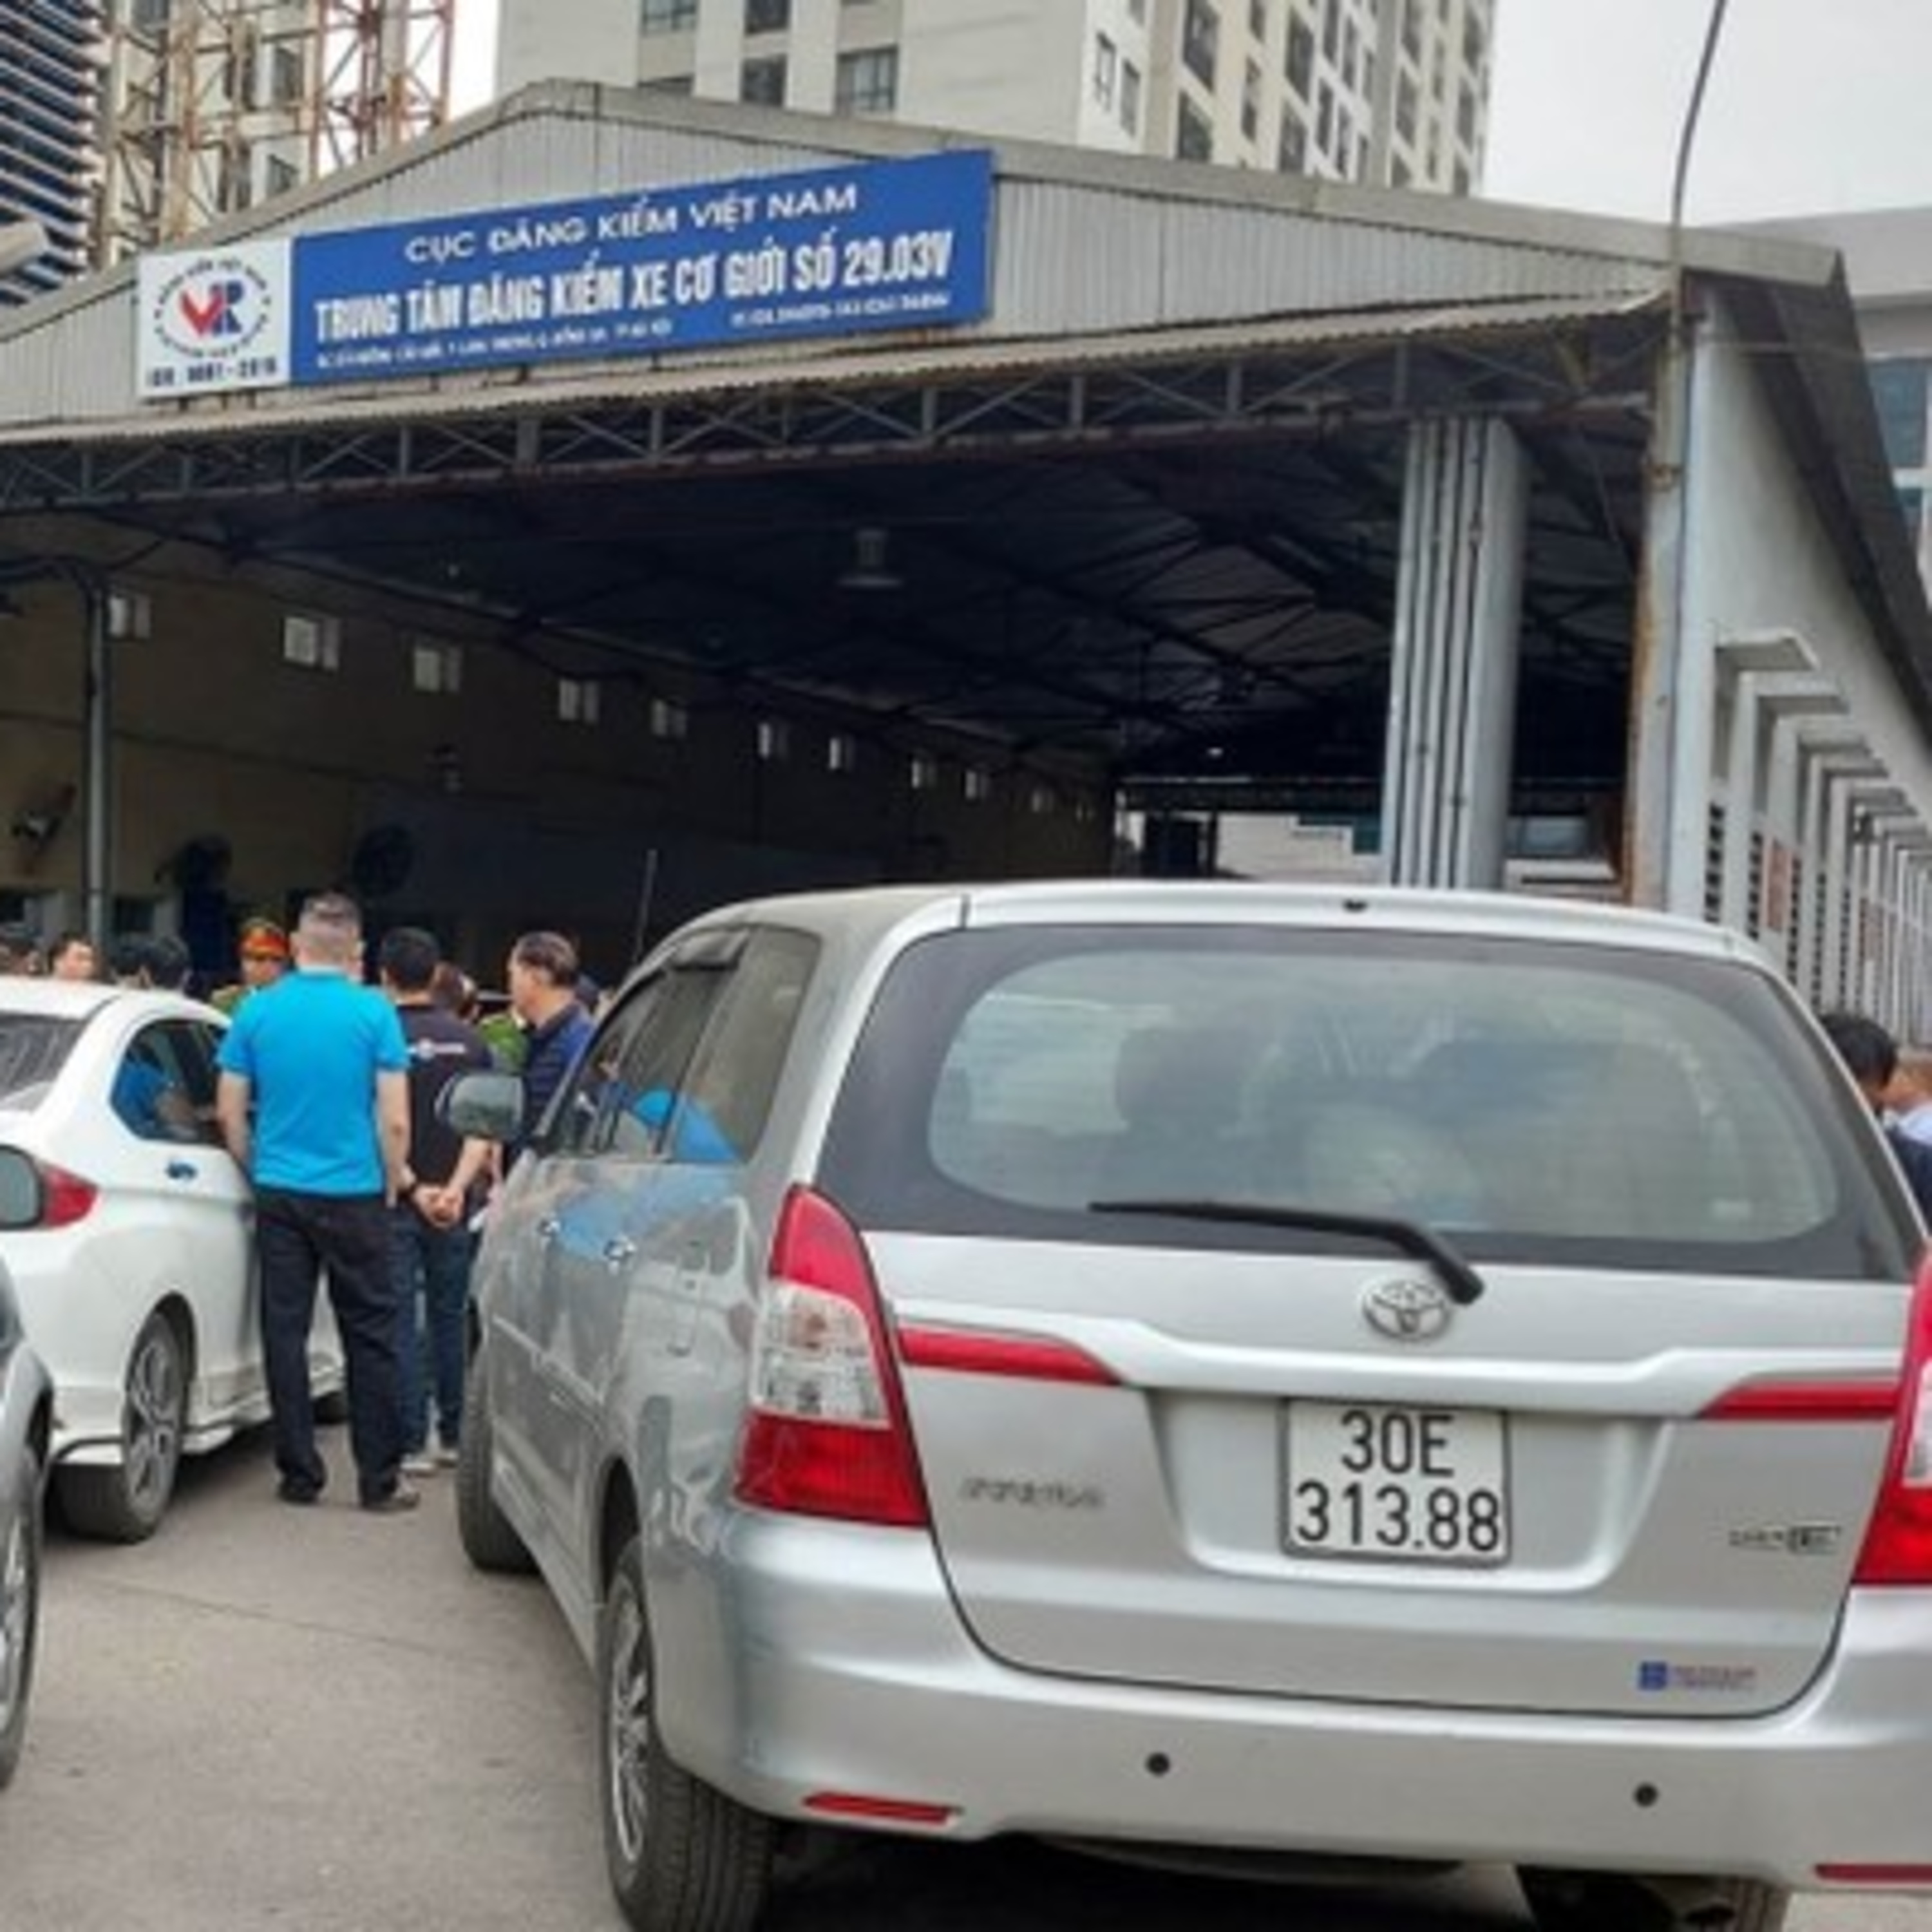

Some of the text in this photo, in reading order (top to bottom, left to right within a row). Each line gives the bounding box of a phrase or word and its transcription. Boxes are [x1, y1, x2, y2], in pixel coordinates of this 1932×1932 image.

[405, 231, 475, 263] CỤC
[690, 191, 755, 232] VIỆT
[768, 184, 857, 219] NAM
[316, 294, 398, 343] TRUNG
[630, 262, 668, 309] XE
[674, 252, 717, 304] CƠ
[724, 236, 786, 298] GIỚI
[793, 227, 837, 290] SỐ
[844, 231, 952, 286] 29.03V
[1341, 1410, 1454, 1477] 30E
[1296, 1480, 1499, 1551] 313.88
